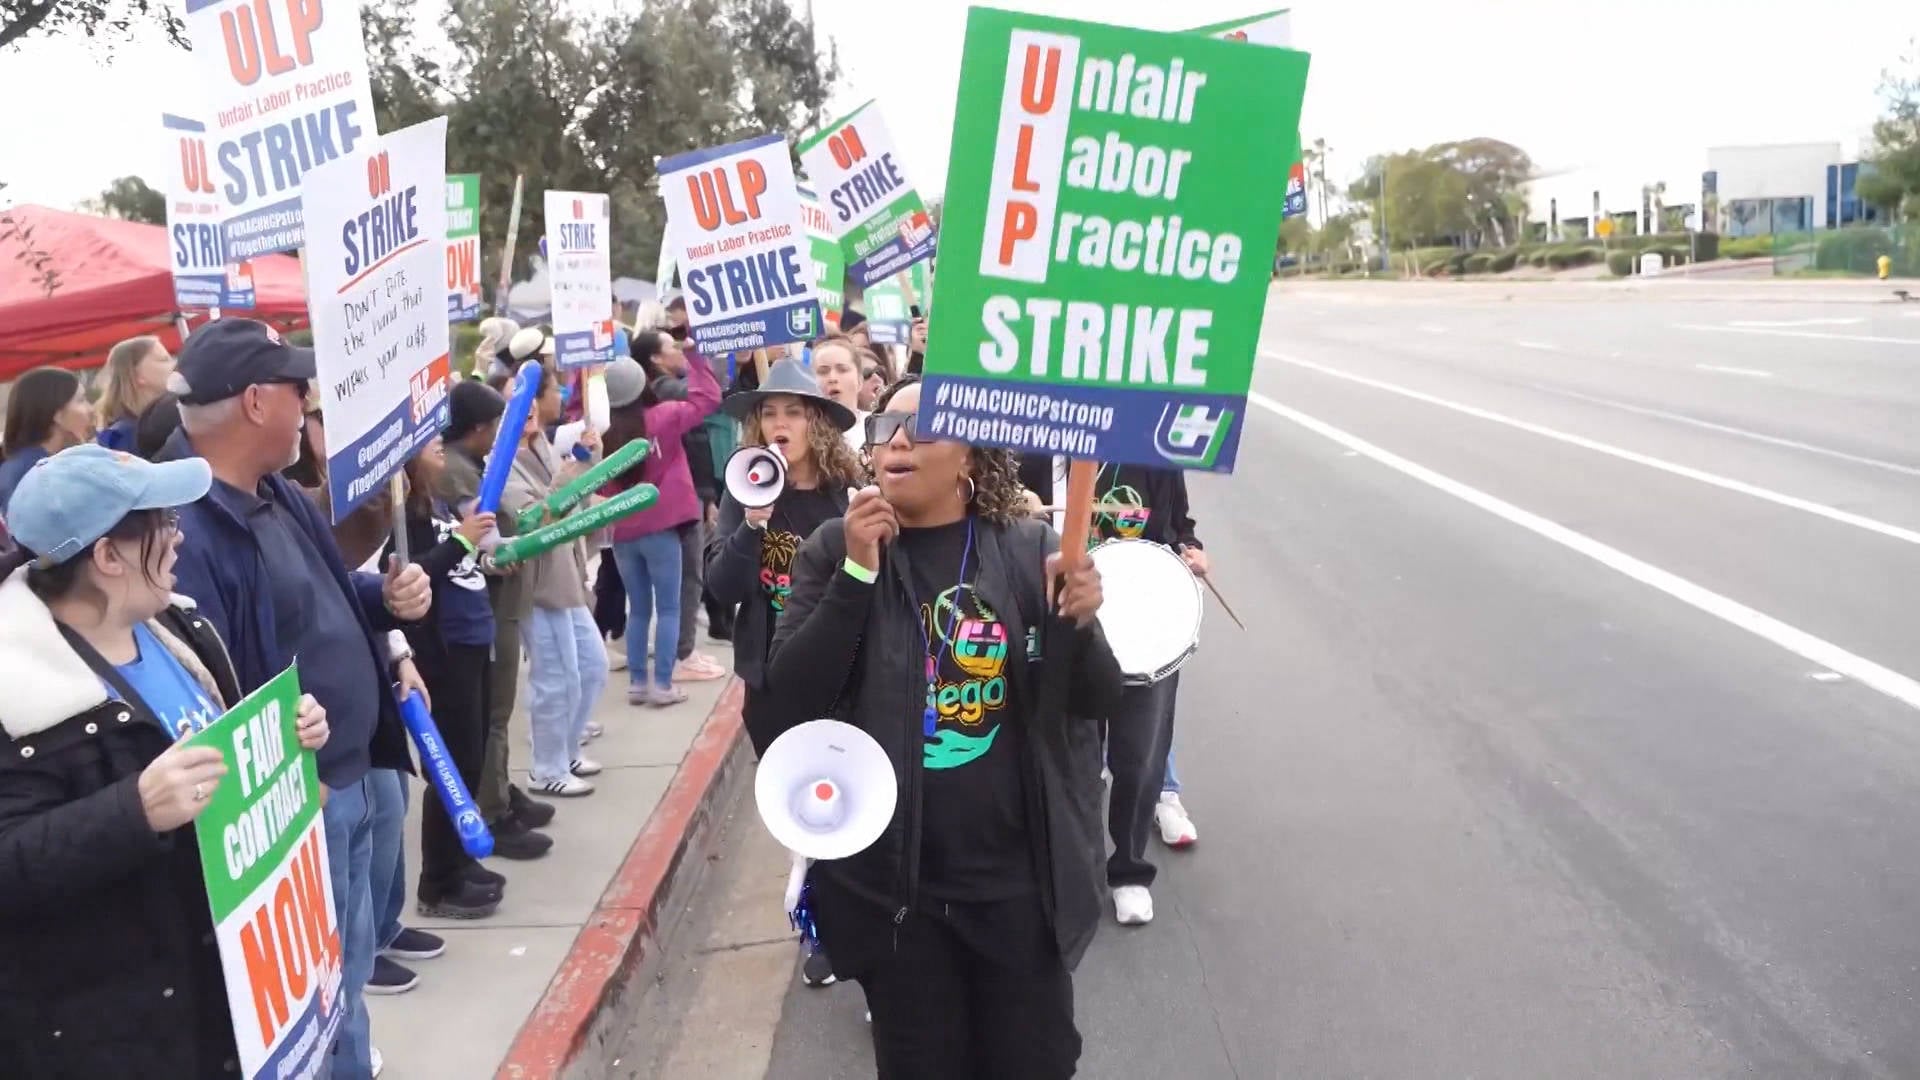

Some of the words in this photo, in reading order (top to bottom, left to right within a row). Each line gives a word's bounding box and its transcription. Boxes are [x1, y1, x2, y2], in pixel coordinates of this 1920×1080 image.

[220, 0, 323, 86] ULP
[218, 100, 254, 128] Unfair
[256, 90, 292, 115] Labor
[295, 70, 352, 101] Practice
[180, 136, 215, 194] UL
[217, 99, 362, 206] STRIKE
[367, 150, 390, 199] ON
[828, 124, 867, 170] ON
[686, 158, 767, 232] ULP
[830, 152, 905, 222] STRIKE
[342, 185, 417, 277] STRIKE
[560, 223, 596, 249] STRIKE
[717, 234, 746, 253] Labor
[748, 223, 792, 243] Practice
[447, 240, 475, 290] OW
[687, 245, 807, 316] STRIKE
[979, 295, 1213, 386] STRIKE
[931, 411, 1097, 455] #TogetherWeWin
[935, 381, 1115, 431] #UNACUHCPstrong
[759, 567, 793, 597] Sa
[937, 676, 1006, 723] ego
[232, 698, 284, 798] FAIR
[223, 753, 308, 881] CONTRACT
[240, 826, 330, 1050] NOW
